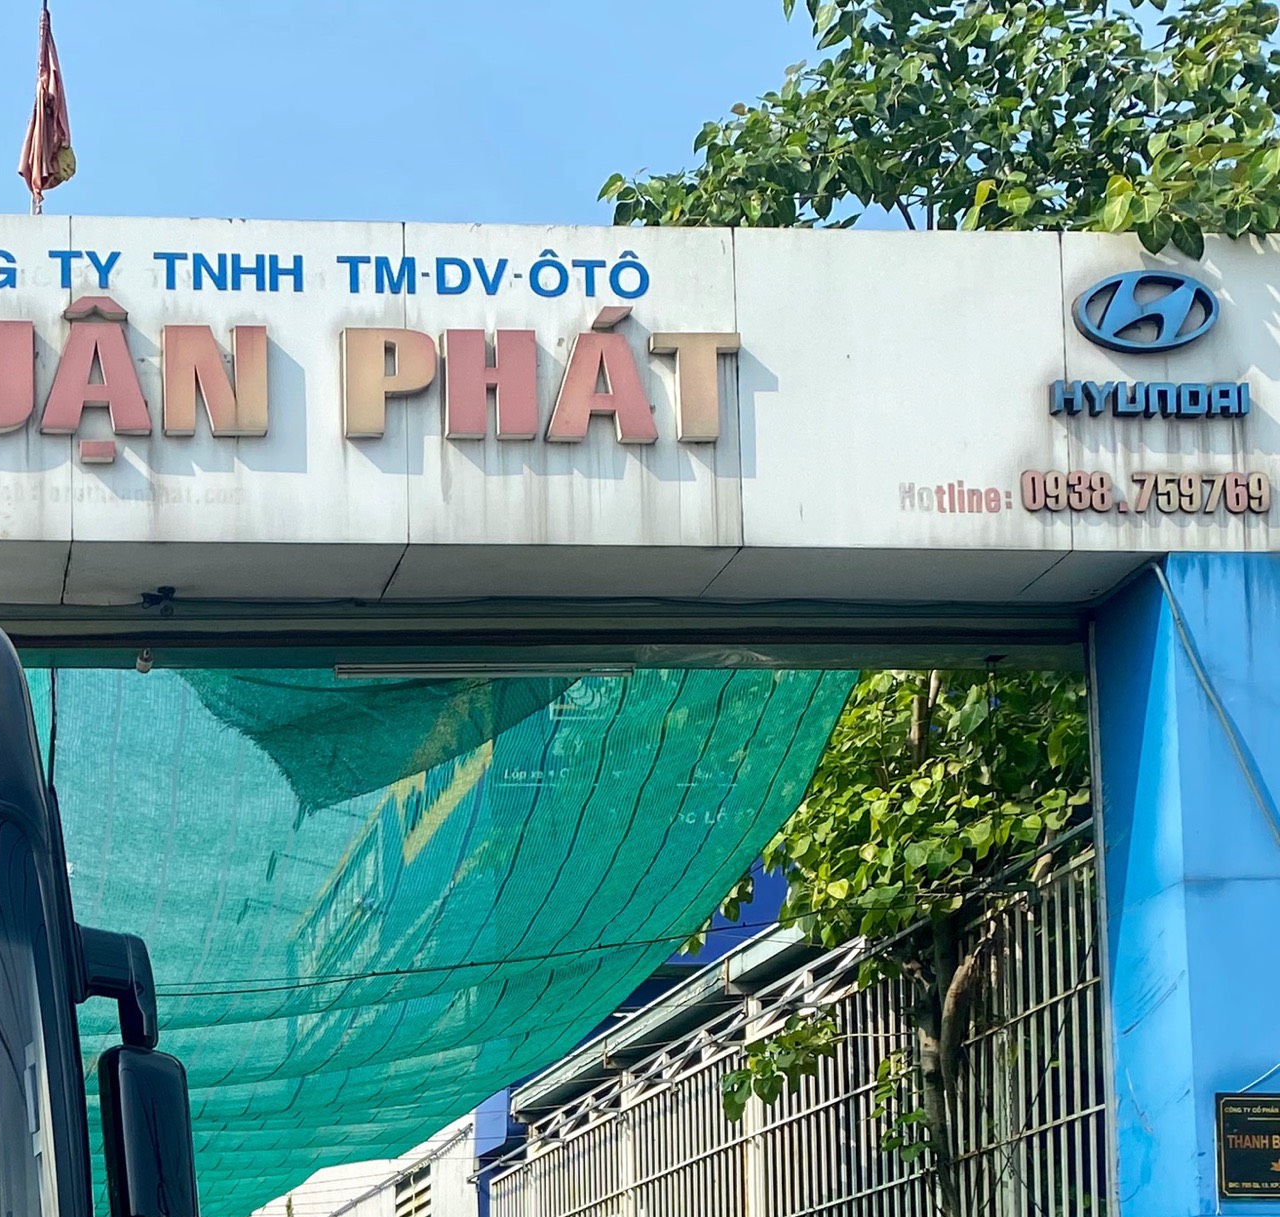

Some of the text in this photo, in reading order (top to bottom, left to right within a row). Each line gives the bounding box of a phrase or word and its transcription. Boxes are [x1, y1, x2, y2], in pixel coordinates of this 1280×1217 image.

[48, 249, 122, 289] TY
[153, 251, 304, 293] TNHH
[340, 306, 741, 445] PHÁT
[1050, 379, 1251, 419] HYUNDAI
[898, 470, 1272, 514] Hotline: 0938.759769
[1227, 1135, 1269, 1149] THANH
